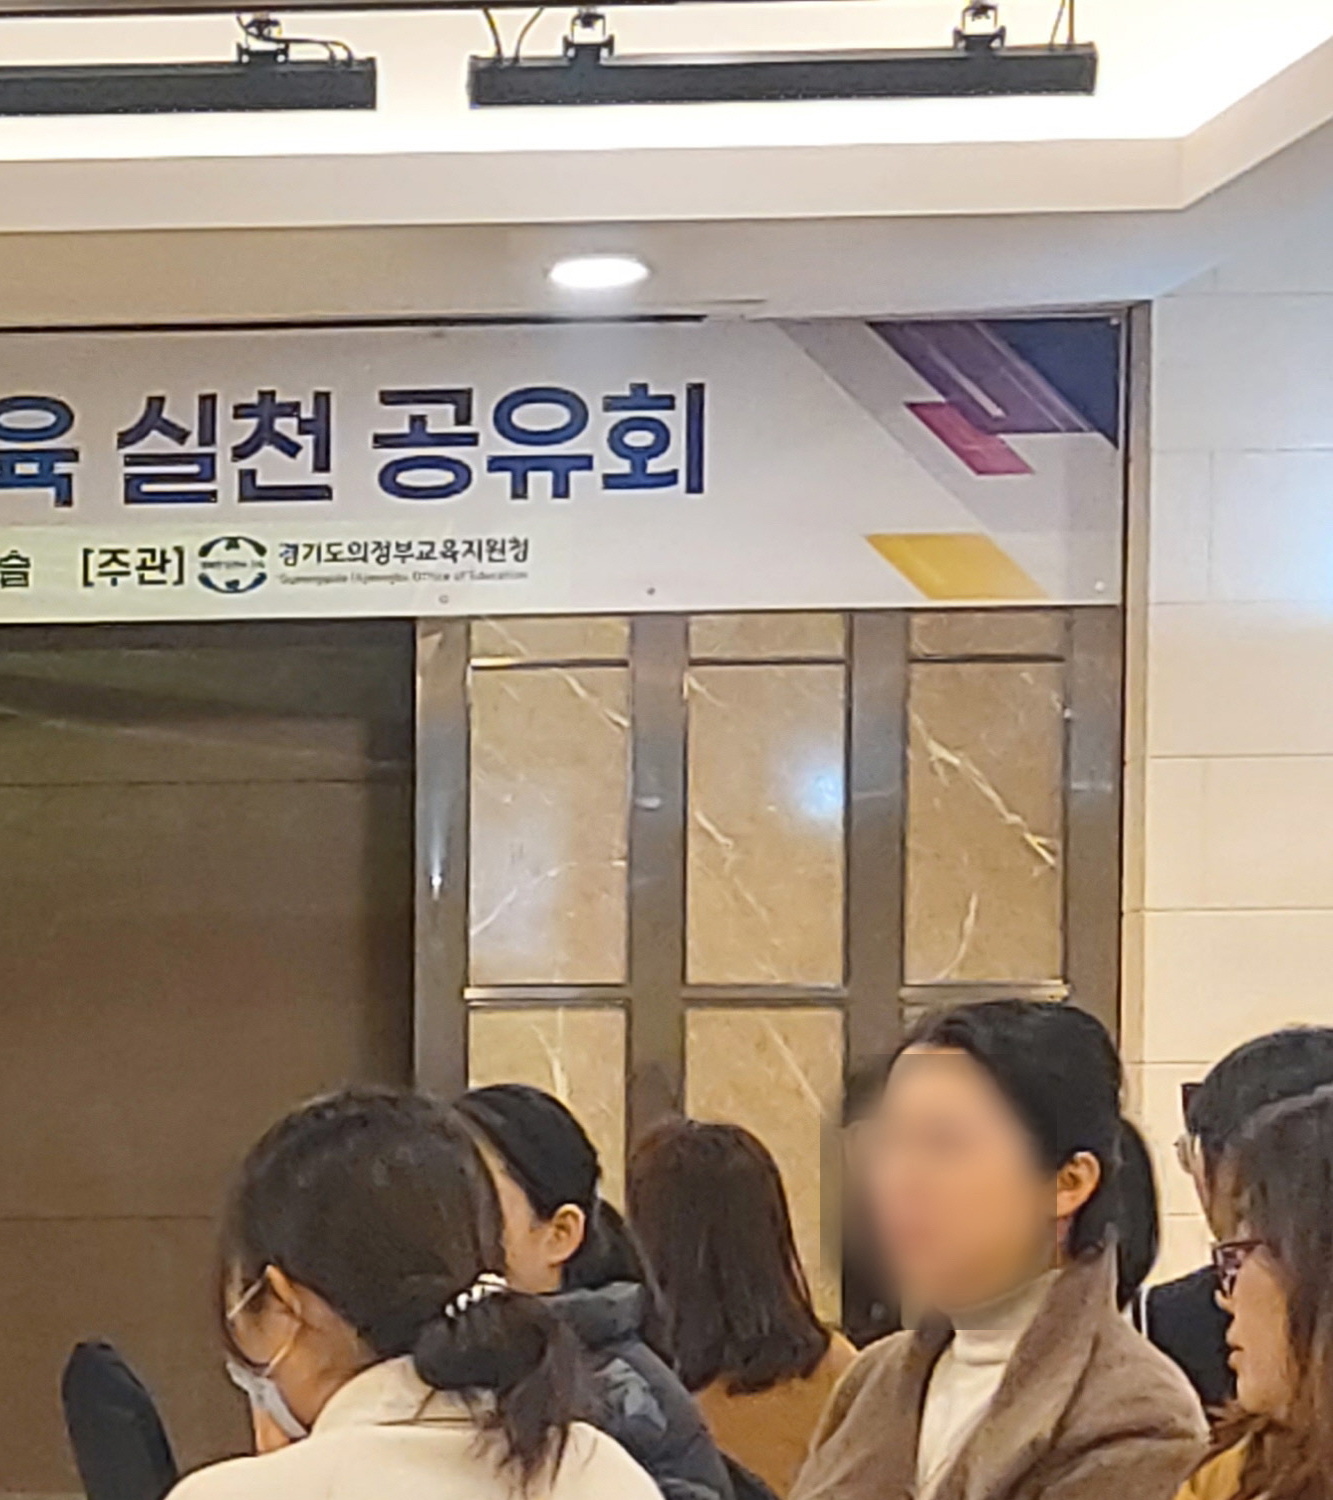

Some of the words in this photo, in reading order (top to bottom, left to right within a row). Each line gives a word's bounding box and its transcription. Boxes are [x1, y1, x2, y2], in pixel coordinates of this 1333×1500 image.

[117, 390, 333, 505] 실천
[373, 383, 705, 500] 공유회
[82, 545, 185, 588] [주관]
[278, 538, 529, 567] 경기도의정부교육지원청
